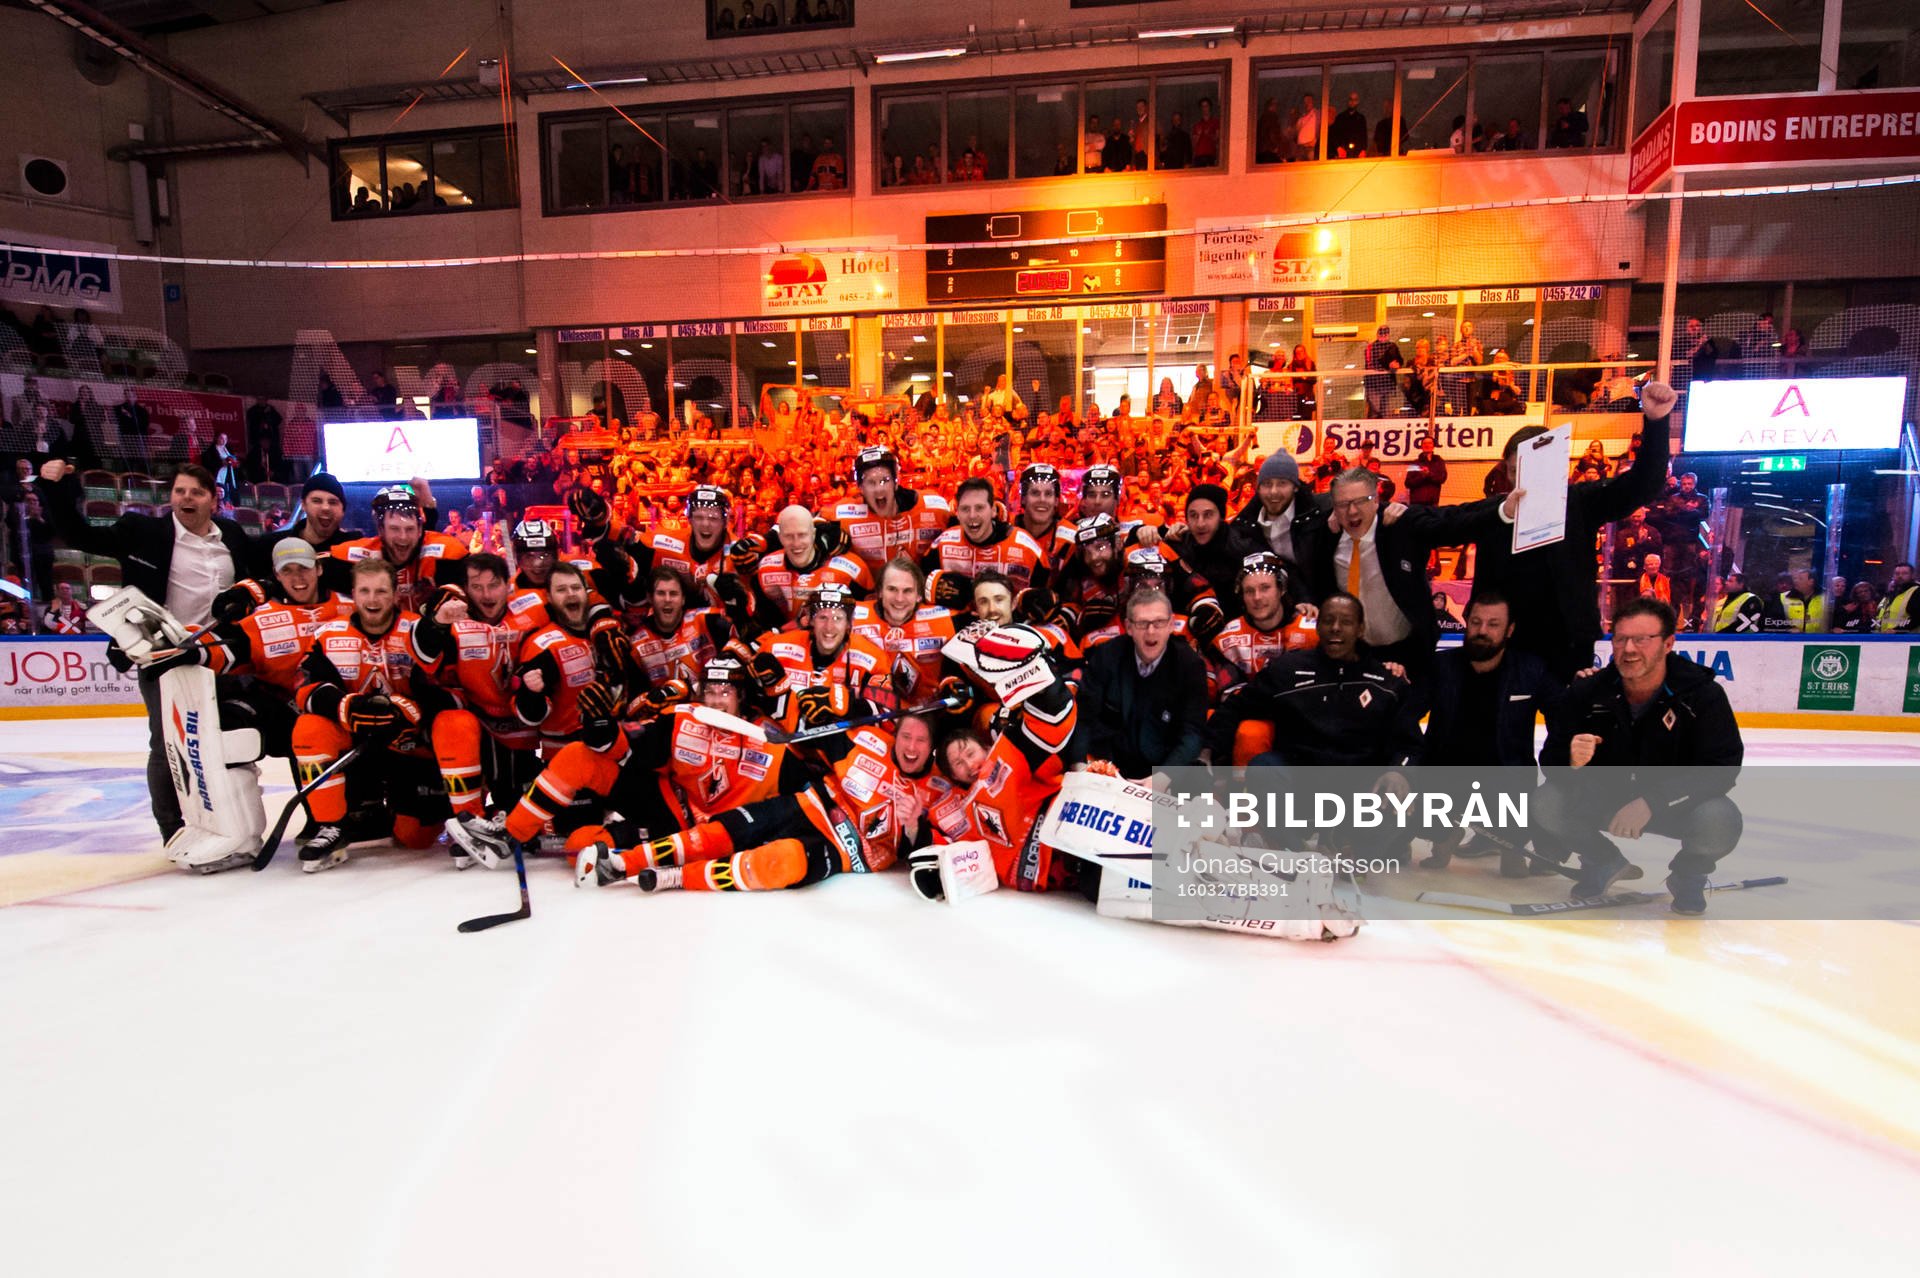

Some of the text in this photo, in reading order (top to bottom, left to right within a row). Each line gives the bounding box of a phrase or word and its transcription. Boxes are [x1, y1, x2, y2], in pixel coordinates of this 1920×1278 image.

[1691, 119, 1776, 144] BODINS
[1632, 122, 1671, 178] BODINS
[1203, 231, 1265, 246] Företags-
[1010, 252, 1019, 260] 10
[1070, 248, 1079, 257] 10
[1200, 249, 1267, 264] lägenheer
[842, 255, 890, 274] Hotel
[1273, 260, 1341, 275] STA
[0, 260, 102, 300] PMG
[767, 283, 828, 299] STAY
[1480, 289, 1520, 302] Glas AB
[1542, 286, 1600, 300] 0455-242 00
[1258, 296, 1296, 310] Glas AB
[1396, 292, 1448, 305] Niklassons
[1090, 305, 1142, 318] 0455-242 00
[1161, 300, 1210, 314] Niklassons
[885, 313, 935, 327] 0455-242 00
[952, 310, 999, 323] Niklassons
[1027, 308, 1062, 321] Glas AB
[678, 322, 725, 336] 0455-242 00
[744, 320, 788, 333] Niklassons
[809, 317, 842, 330] Glas AB
[560, 329, 602, 342] Niklassons
[622, 326, 654, 338] Glas AB
[206, 408, 238, 421] hem!
[1325, 421, 1493, 457] Sängjätten
[1739, 429, 1839, 444] AREVA
[261, 613, 289, 626] SAVE
[269, 641, 296, 653] BAGA
[330, 640, 359, 648] SAVE
[1005, 665, 1042, 691] VAUGHN
[14, 685, 32, 694] när
[37, 684, 67, 696] riktigt
[71, 684, 91, 696] gott
[94, 683, 120, 693] kaffe
[1822, 682, 1849, 691] ERIKS
[186, 711, 199, 735] BIL
[860, 756, 882, 775] SAVE
[1059, 801, 1157, 848] BERGS BIL
